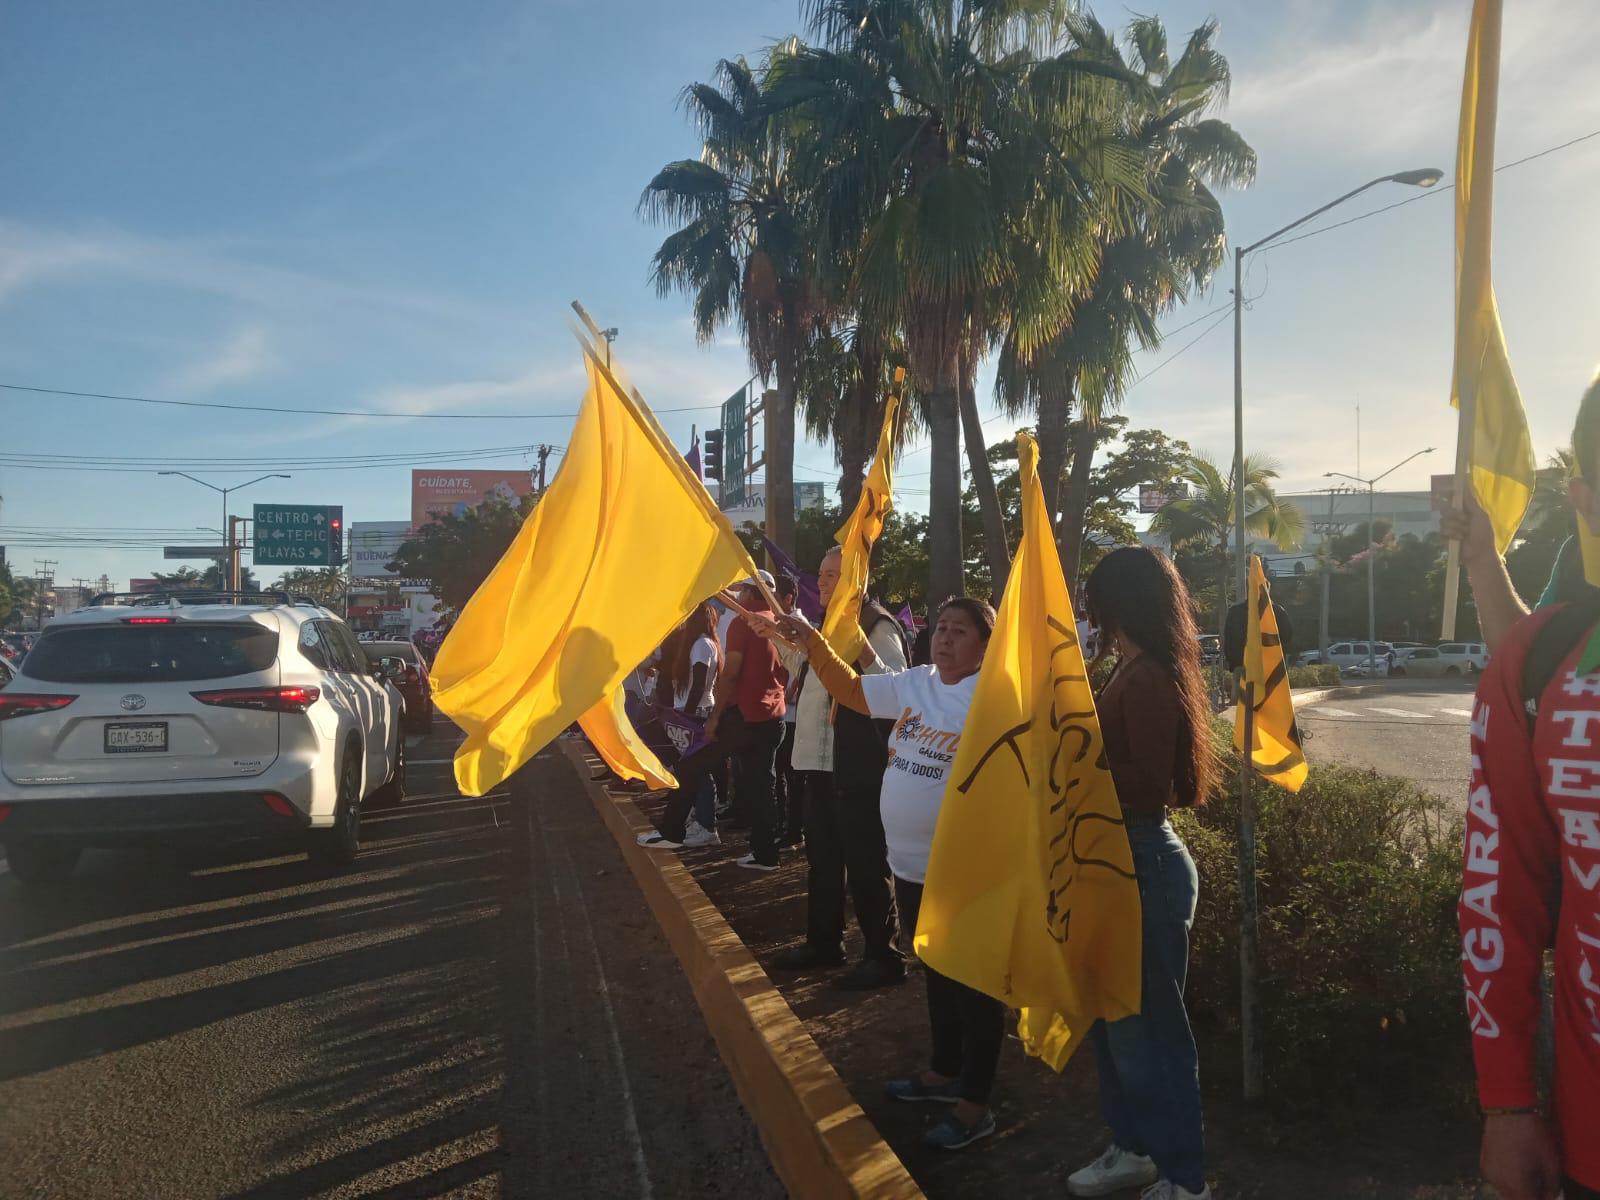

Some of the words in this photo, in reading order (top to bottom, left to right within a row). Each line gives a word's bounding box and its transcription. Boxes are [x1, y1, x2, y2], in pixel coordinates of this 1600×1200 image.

[257, 511, 309, 523] CENTRO
[287, 529, 328, 542] TEPIC
[259, 546, 305, 559] PLAYAS
[908, 762, 944, 781] TODOS!
